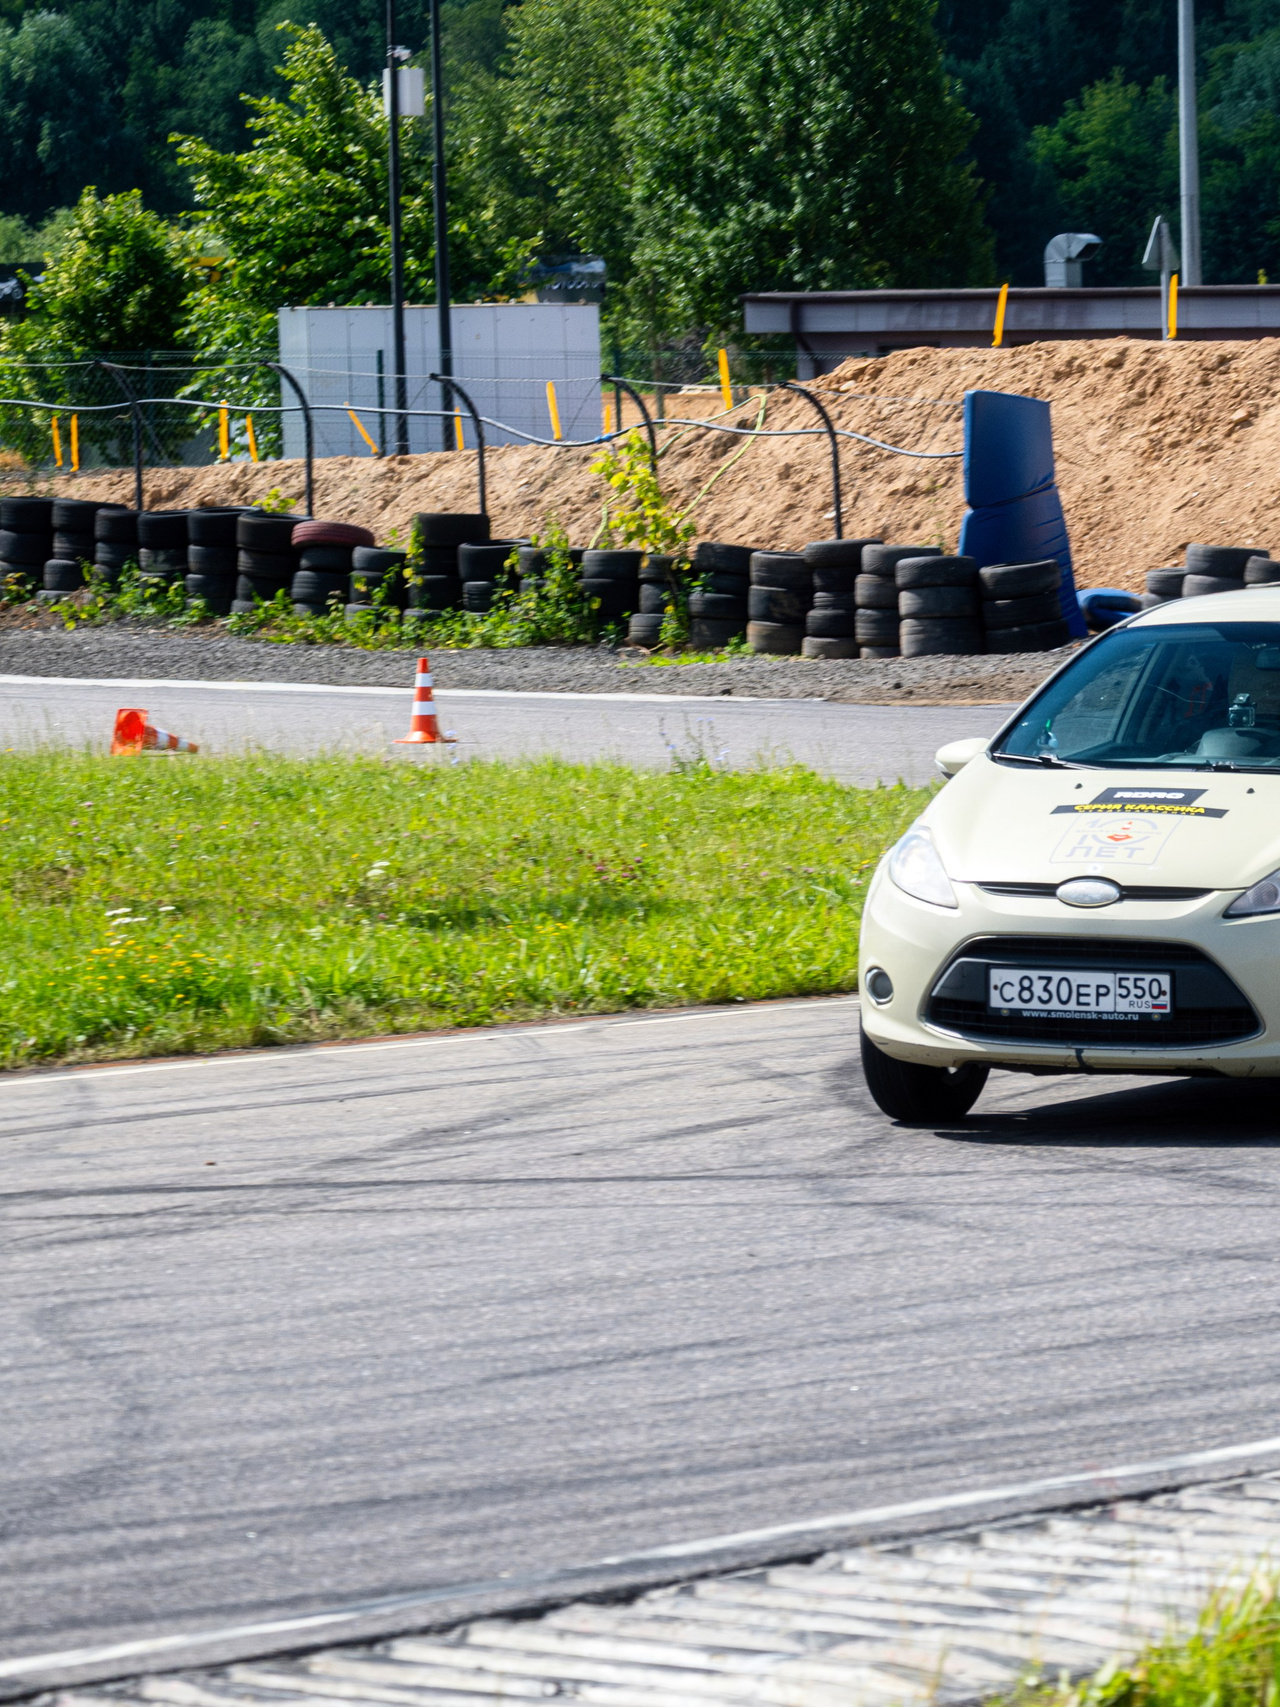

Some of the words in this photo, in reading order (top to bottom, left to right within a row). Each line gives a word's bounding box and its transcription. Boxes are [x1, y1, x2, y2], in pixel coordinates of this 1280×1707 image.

[1124, 804, 1205, 814] КЛАССИКА
[1065, 845, 1145, 858] ЛЕТ
[999, 975, 1111, 1007] С830ЕР
[1117, 977, 1163, 1000] 550
[1128, 1000, 1151, 1010] RUS
[1022, 1009, 1139, 1021] www.smolensk-auto.ru
